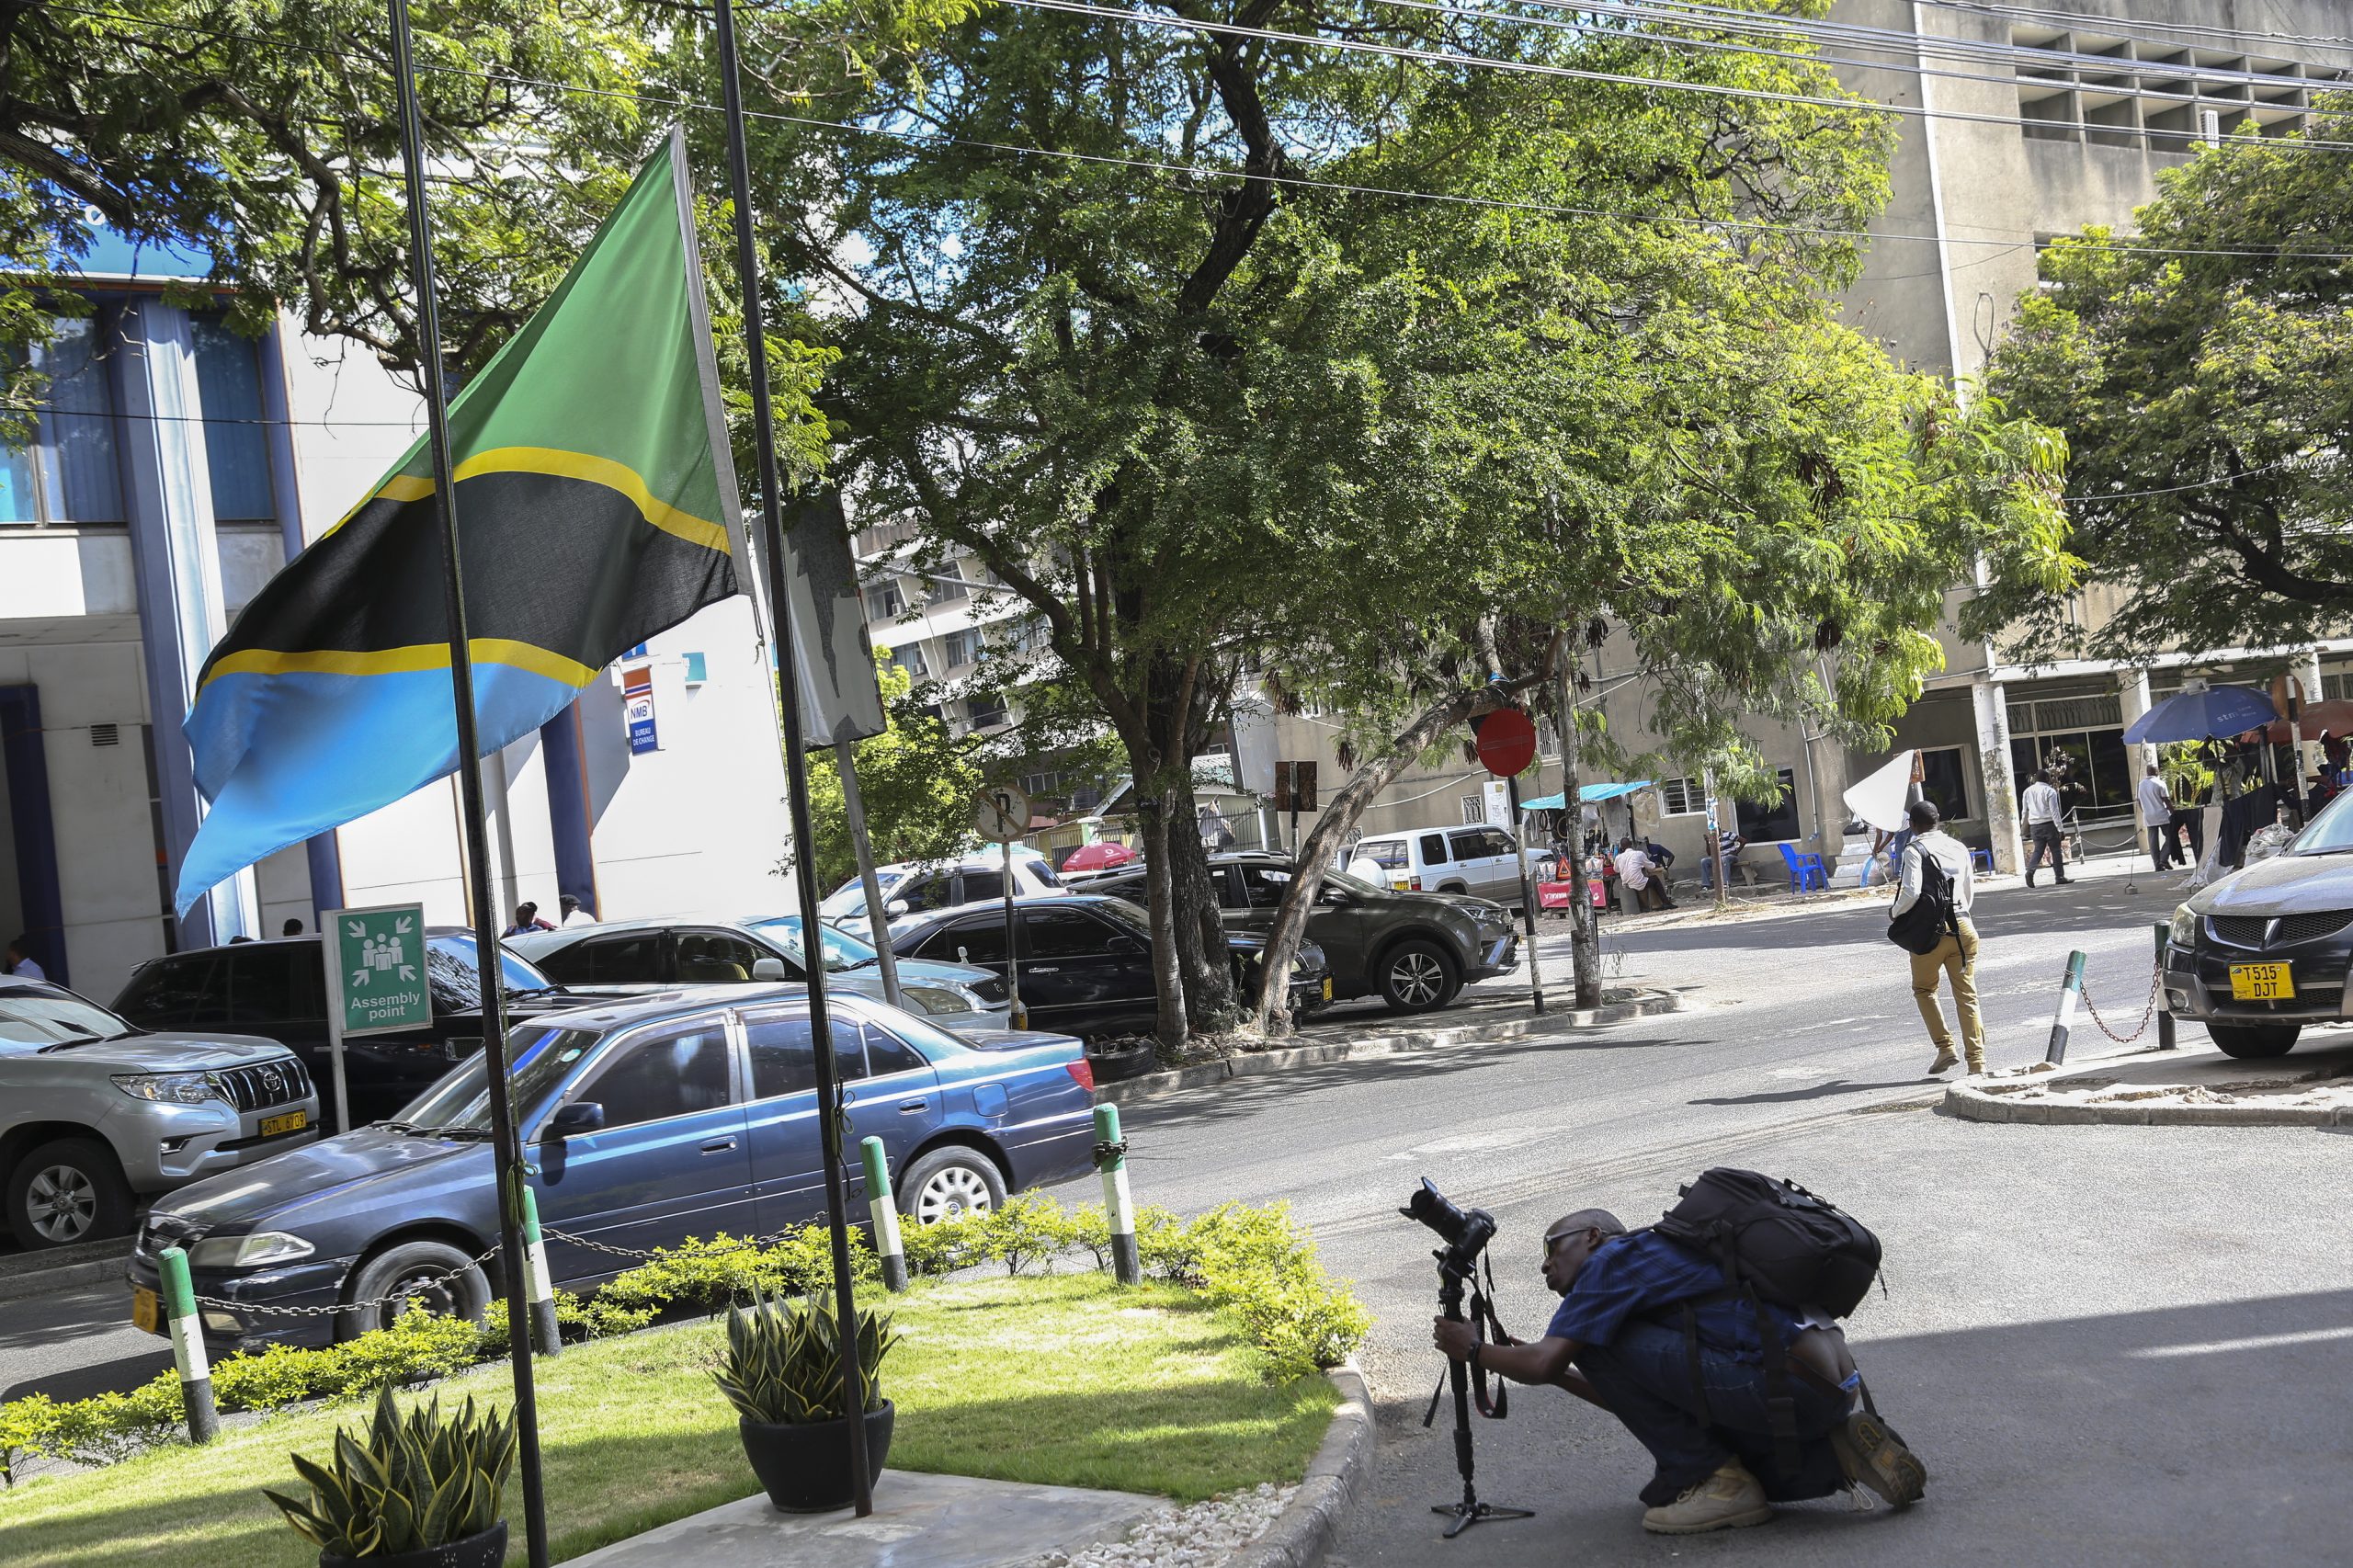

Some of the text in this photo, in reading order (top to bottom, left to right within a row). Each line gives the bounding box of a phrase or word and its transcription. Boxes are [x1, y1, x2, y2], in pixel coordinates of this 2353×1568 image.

[631, 705, 648, 720] NMB
[634, 727, 651, 737] BUREAU
[632, 734, 655, 746] DE CHANGE
[2243, 965, 2278, 981] T515
[2254, 982, 2278, 997] DJT
[351, 992, 421, 1009] Assembly
[369, 1005, 406, 1022] point
[267, 1119, 281, 1132] STL
